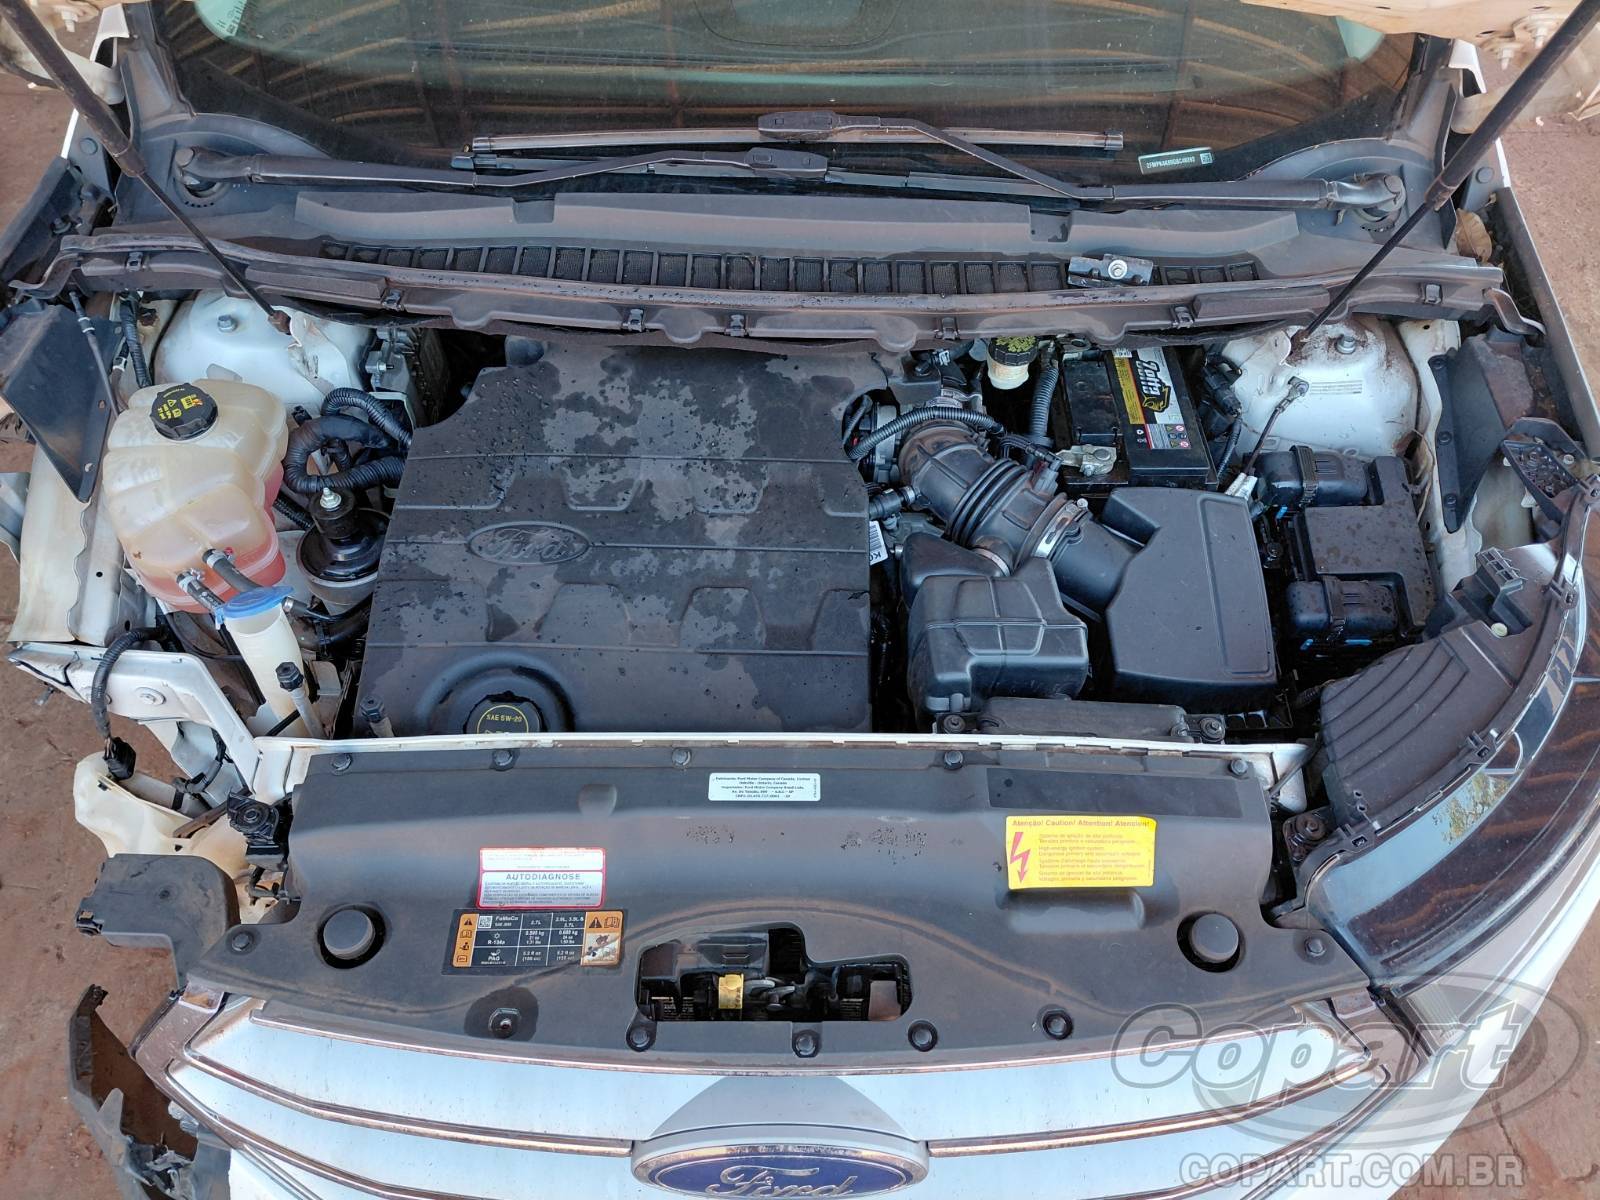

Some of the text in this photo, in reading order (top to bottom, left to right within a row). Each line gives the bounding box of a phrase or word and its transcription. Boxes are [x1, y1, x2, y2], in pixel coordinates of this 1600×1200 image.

[1045, 819, 1076, 827] Caution!
[505, 873, 581, 881] AUTODIAGNOSE
[705, 1165, 858, 1197] Ford
